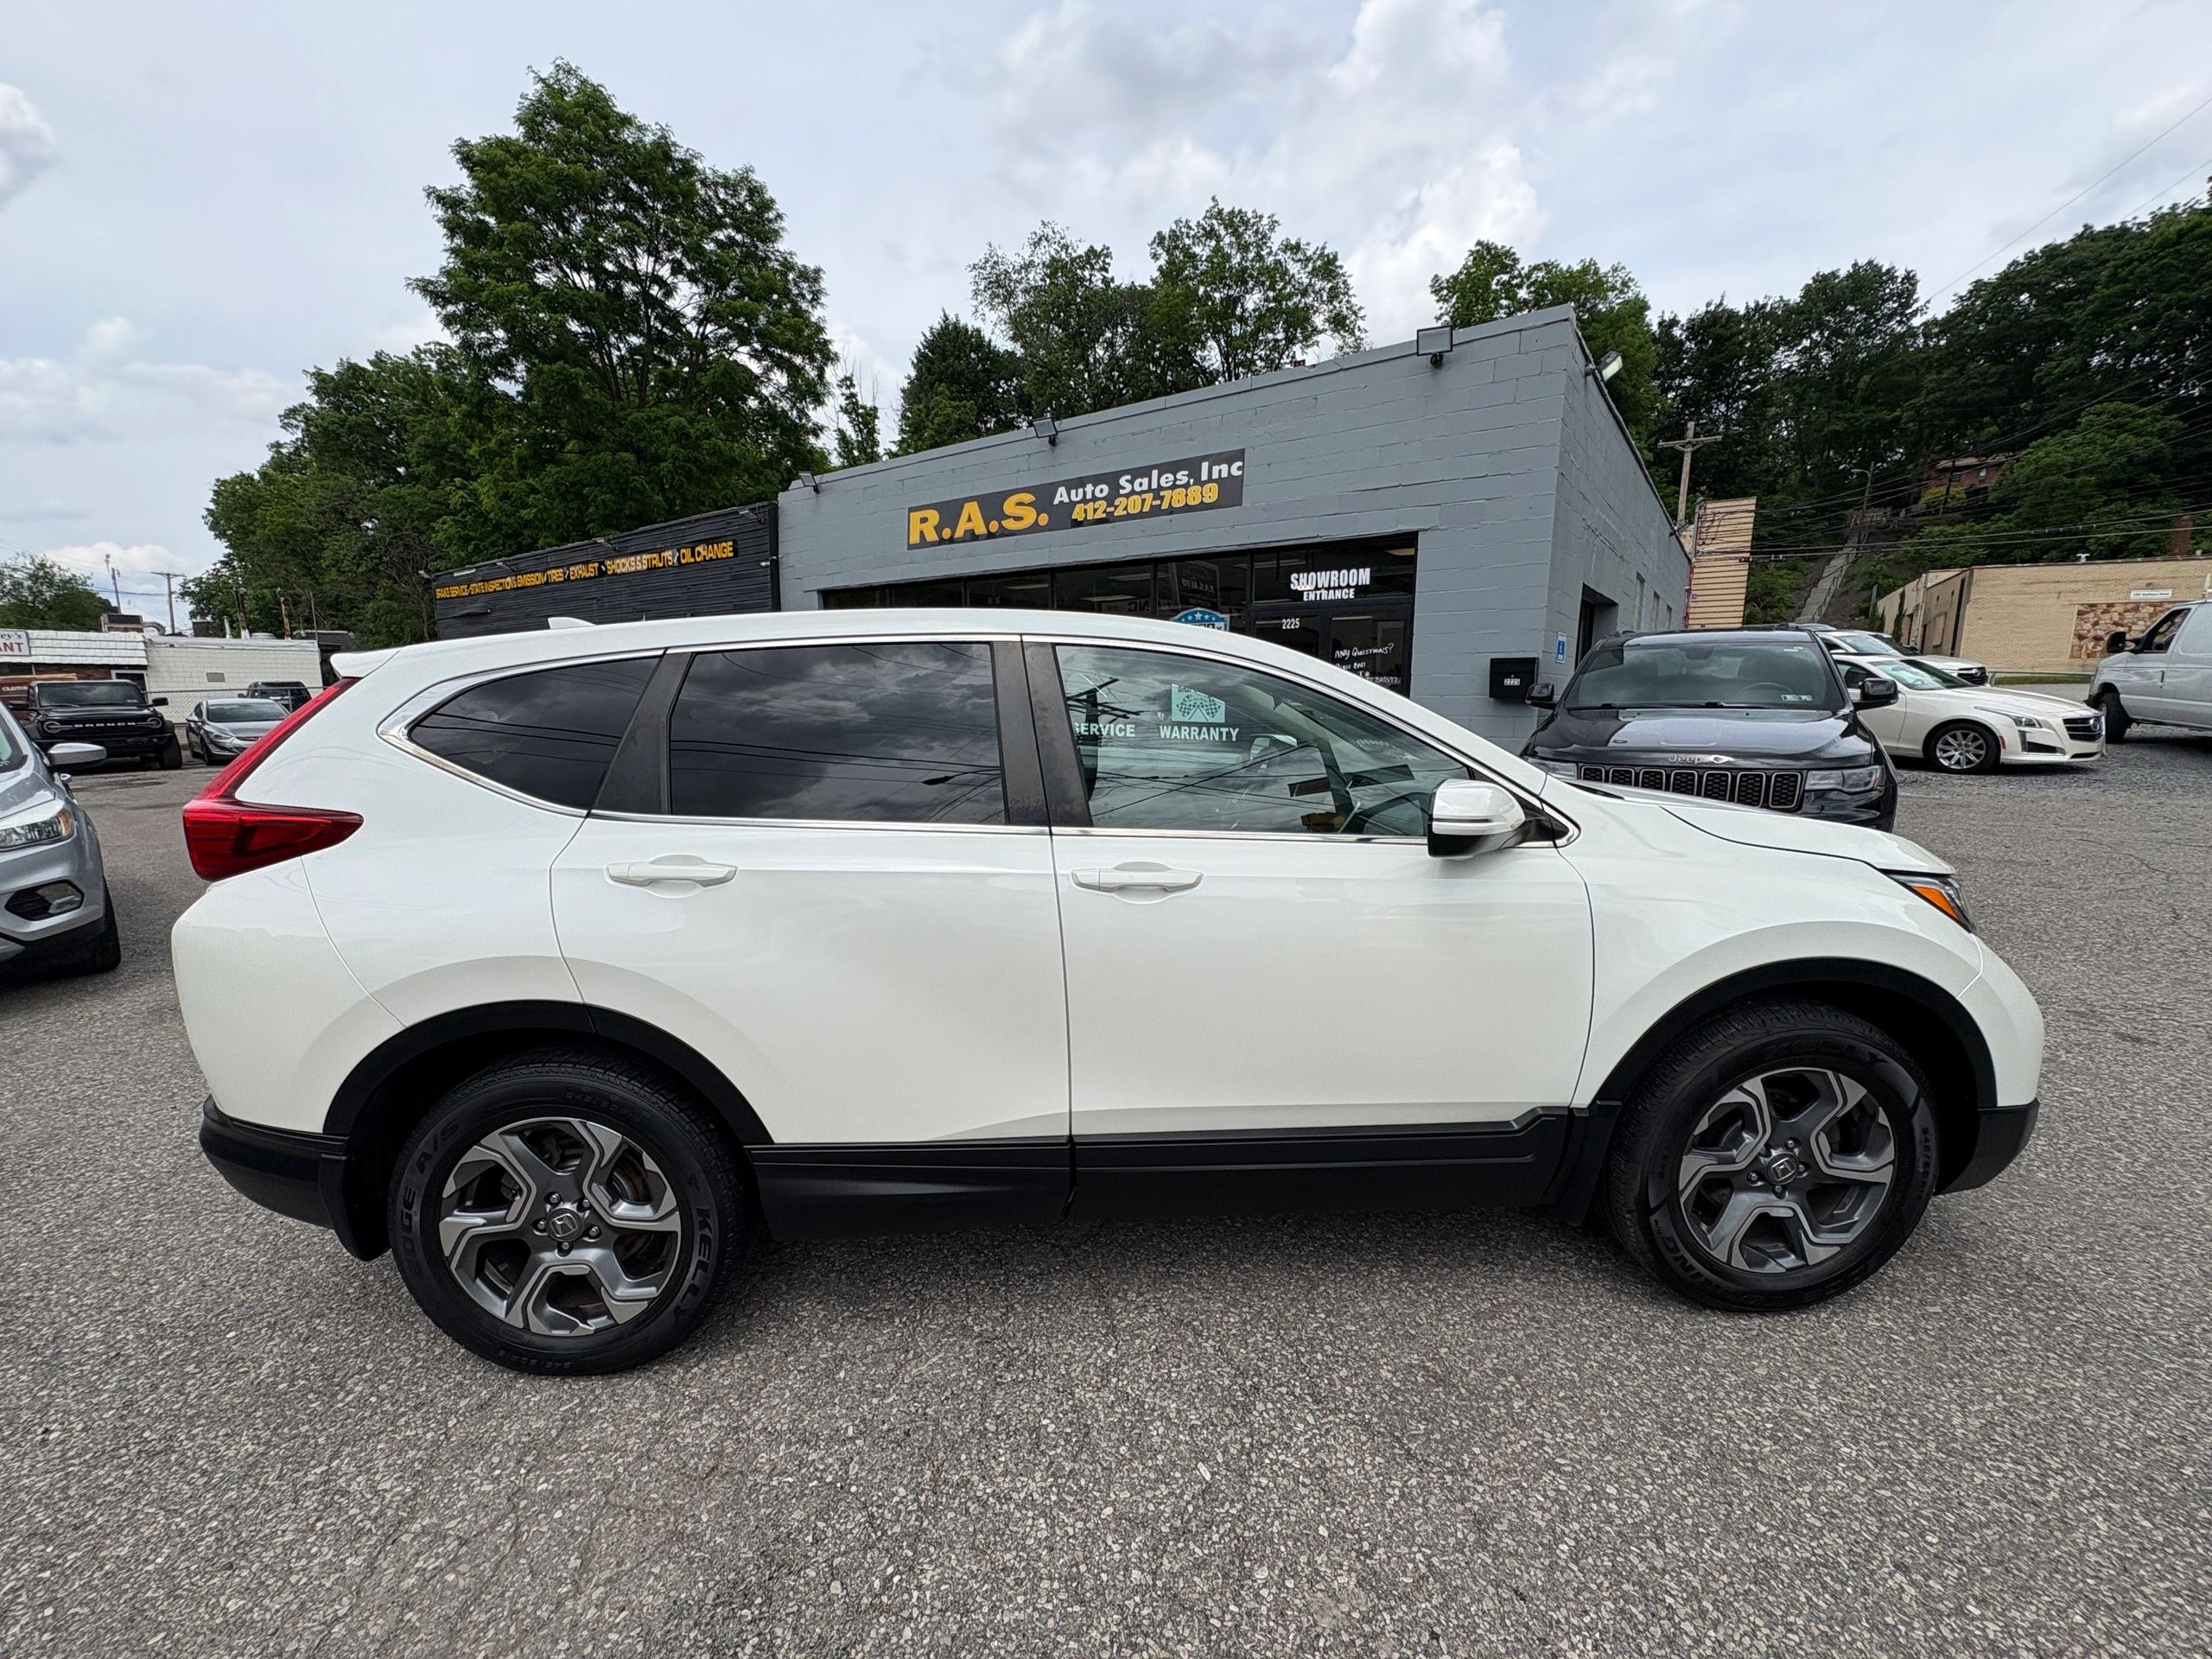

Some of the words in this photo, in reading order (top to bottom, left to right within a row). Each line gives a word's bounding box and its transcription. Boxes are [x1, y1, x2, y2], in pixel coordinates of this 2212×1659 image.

[1052, 483, 1109, 505] Auto
[1118, 469, 1192, 495] Sales,
[1200, 459, 1243, 482] Inc
[1071, 482, 1218, 522] 412-207-7889
[908, 493, 1049, 544] R.A.S.
[547, 568, 564, 583] TIRES
[569, 562, 599, 581] EXHAUST
[607, 555, 636, 575] SHOCKS
[643, 550, 673, 569] STRUTS
[680, 547, 696, 564] OIL
[695, 541, 734, 562] CHANGE
[1290, 568, 1371, 590] SHOWROOM
[1303, 588, 1356, 601] ENTRANCE
[1281, 618, 1300, 630] 2225
[1074, 722, 1136, 738] SERVICE
[1159, 725, 1240, 742] WARRANTY
[1668, 753, 1703, 766] Jeep
[672, 1207, 713, 1322] KELLY
